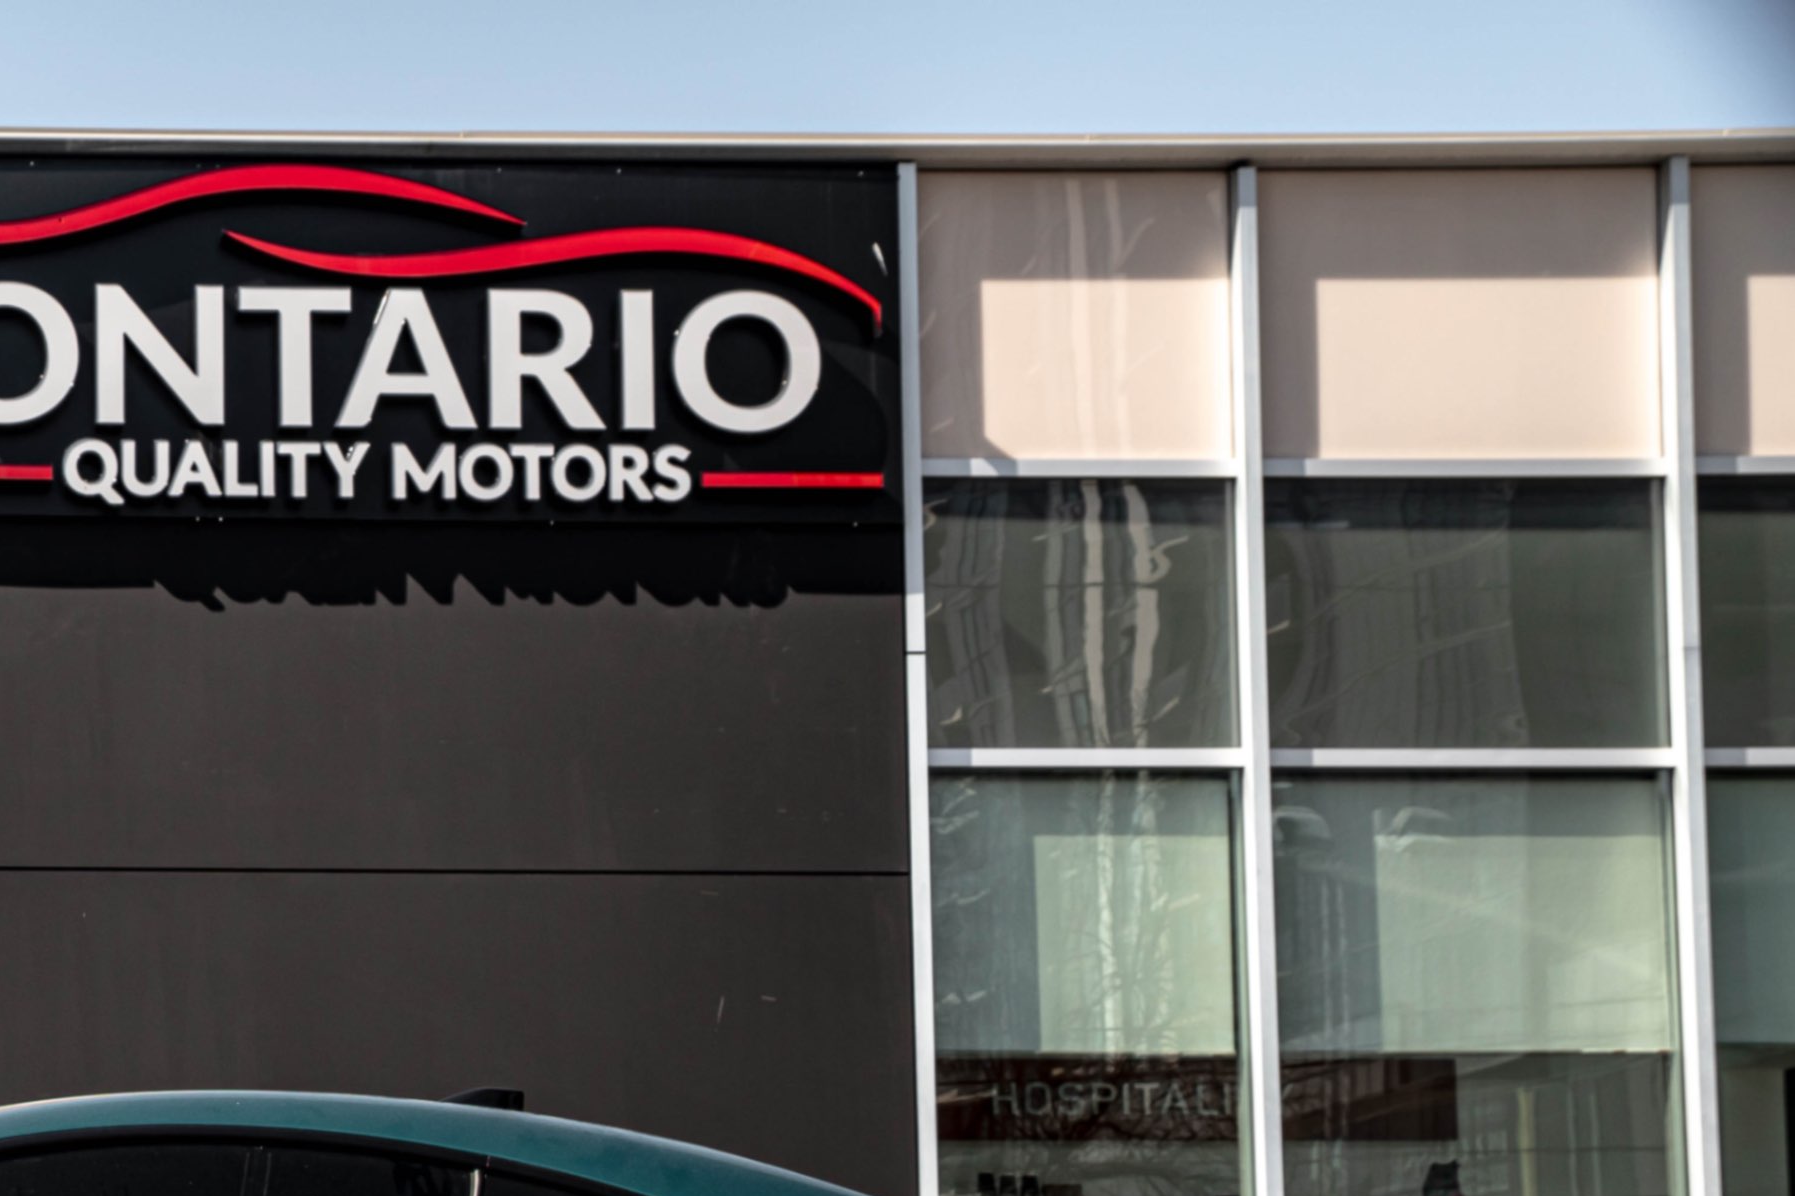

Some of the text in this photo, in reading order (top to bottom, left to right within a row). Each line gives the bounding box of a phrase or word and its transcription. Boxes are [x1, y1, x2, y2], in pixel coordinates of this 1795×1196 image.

[63, 439, 692, 505] QUALITY MOTORS
[991, 1078, 1296, 1118] HOSPITALI
